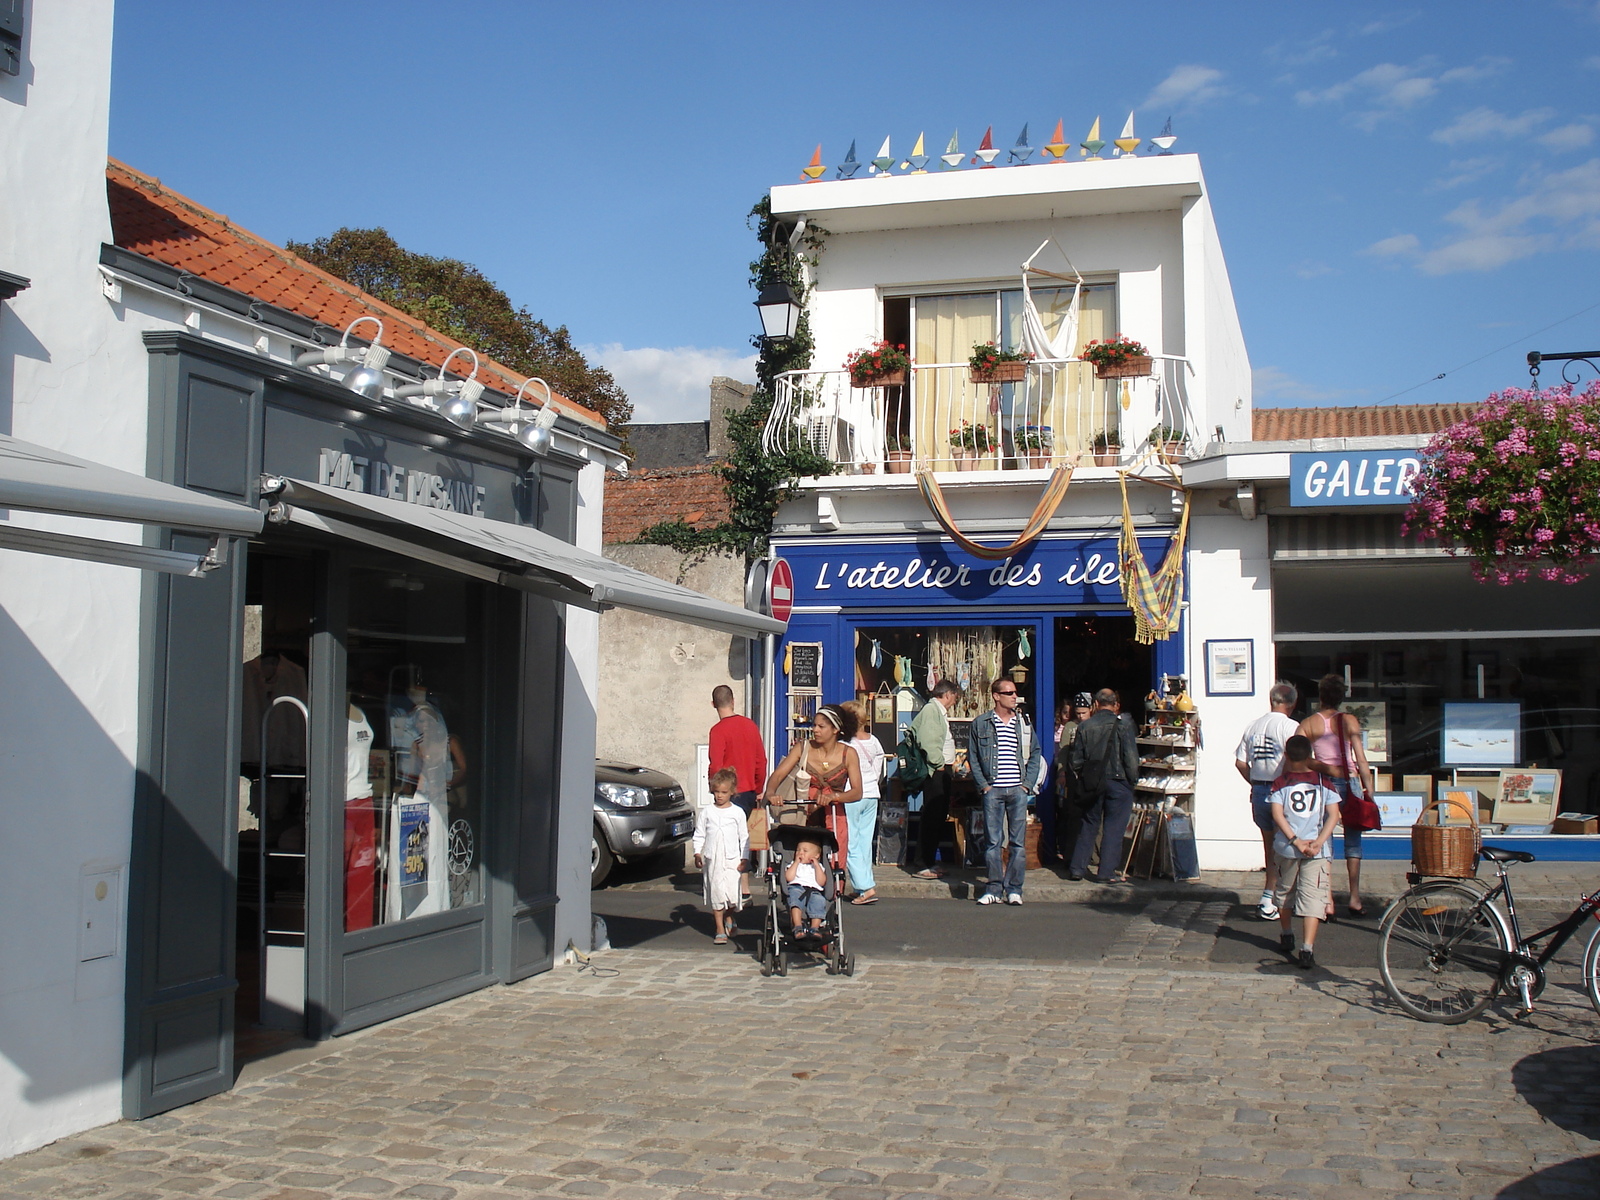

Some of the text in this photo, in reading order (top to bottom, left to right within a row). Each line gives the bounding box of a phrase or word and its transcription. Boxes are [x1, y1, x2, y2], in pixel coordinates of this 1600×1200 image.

[319, 447, 486, 519] MAT DE MISAINE
[1304, 457, 1436, 498] GALER
[814, 553, 1123, 590] L'atelier des ile
[1290, 789, 1317, 813] 87
[403, 854, 424, 874] -50%
